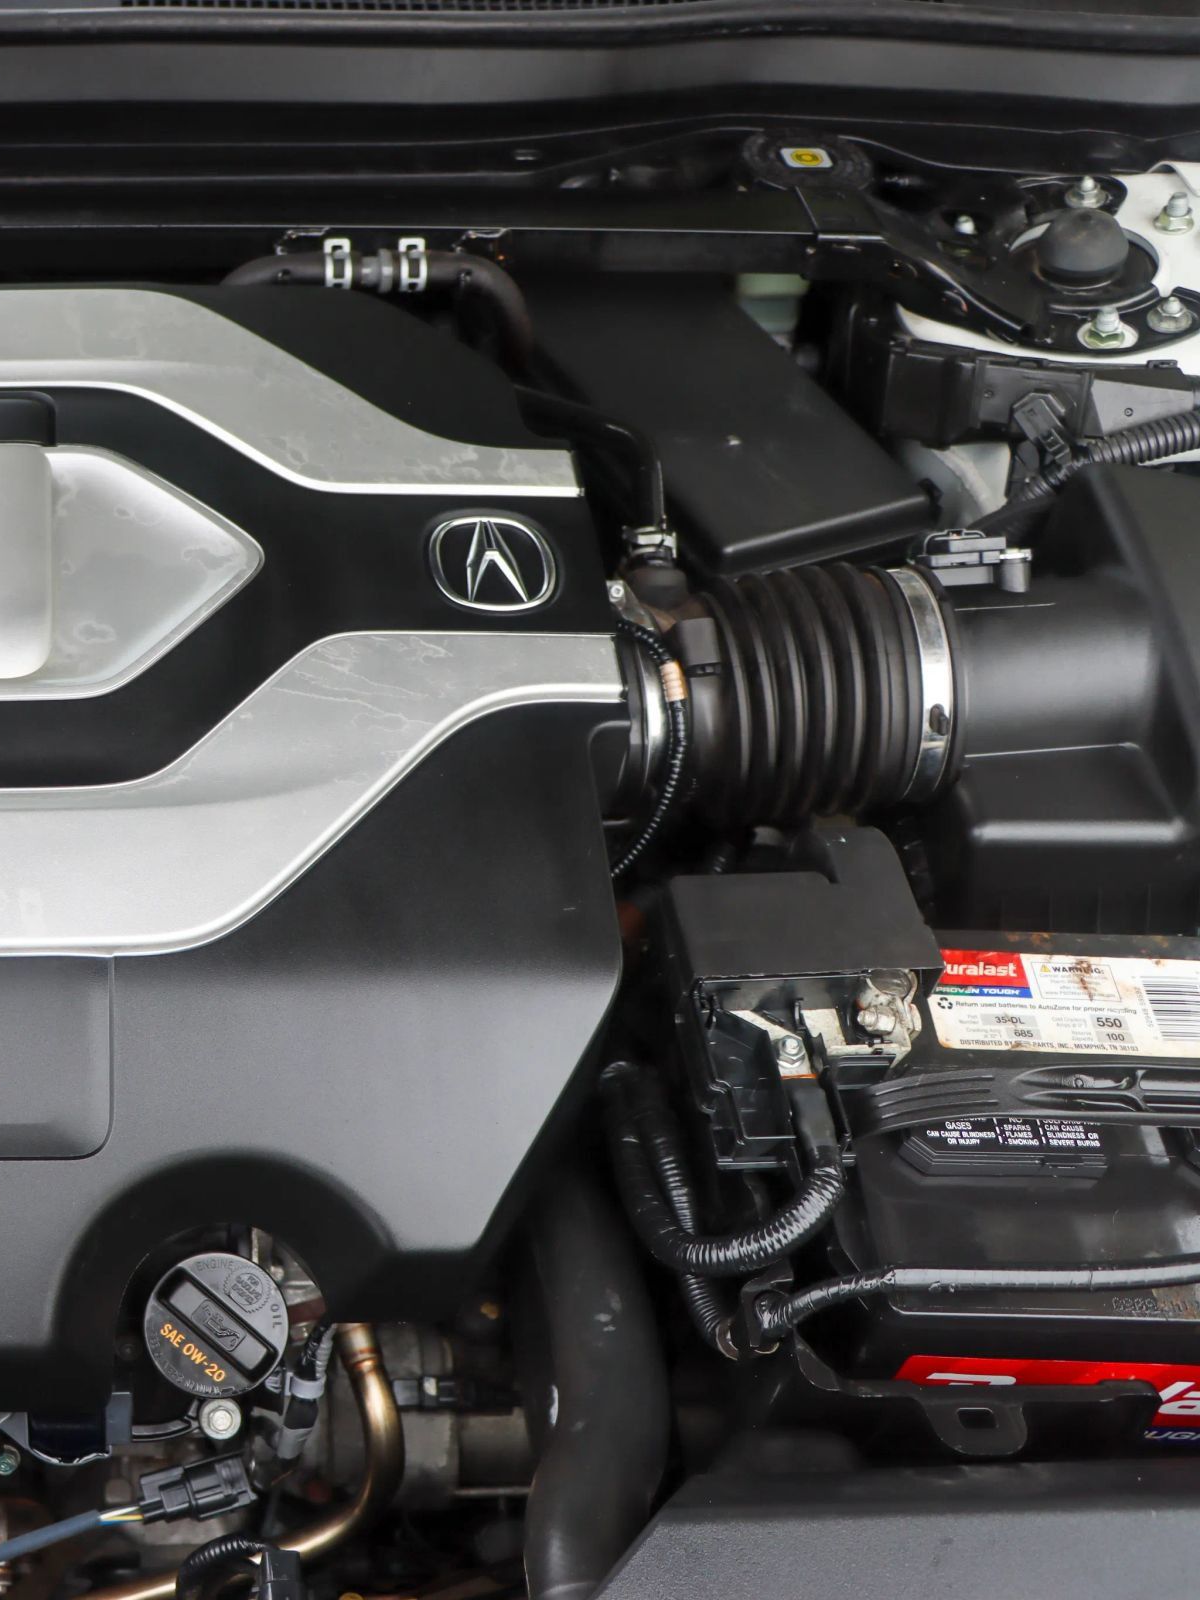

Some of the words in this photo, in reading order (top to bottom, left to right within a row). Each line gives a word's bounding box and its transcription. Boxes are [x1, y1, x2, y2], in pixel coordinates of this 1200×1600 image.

[935, 986, 980, 994] PROVEN
[994, 1016, 1025, 1025] 35-DL
[1096, 1017, 1122, 1028] 550
[1014, 1030, 1034, 1038] 685
[1105, 1033, 1125, 1041] 100
[1032, 1041, 1056, 1049] PARTS,
[1074, 1043, 1108, 1051] MEMPHIS,
[945, 1121, 972, 1130] GASES
[940, 1130, 961, 1138] CAUSE
[1005, 1131, 1032, 1139] FLAMES
[1046, 1131, 1086, 1139] BLINDNESS
[1087, 1132, 1099, 1140] OR
[1007, 1138, 1039, 1146] SMOKING
[1049, 1138, 1075, 1146] SEVERE
[1076, 1139, 1101, 1147] BURNS
[196, 1258, 235, 1271] ENGINE
[270, 1303, 282, 1329] OIL
[160, 1323, 186, 1348] SAE
[182, 1343, 226, 1382] 0W-20
